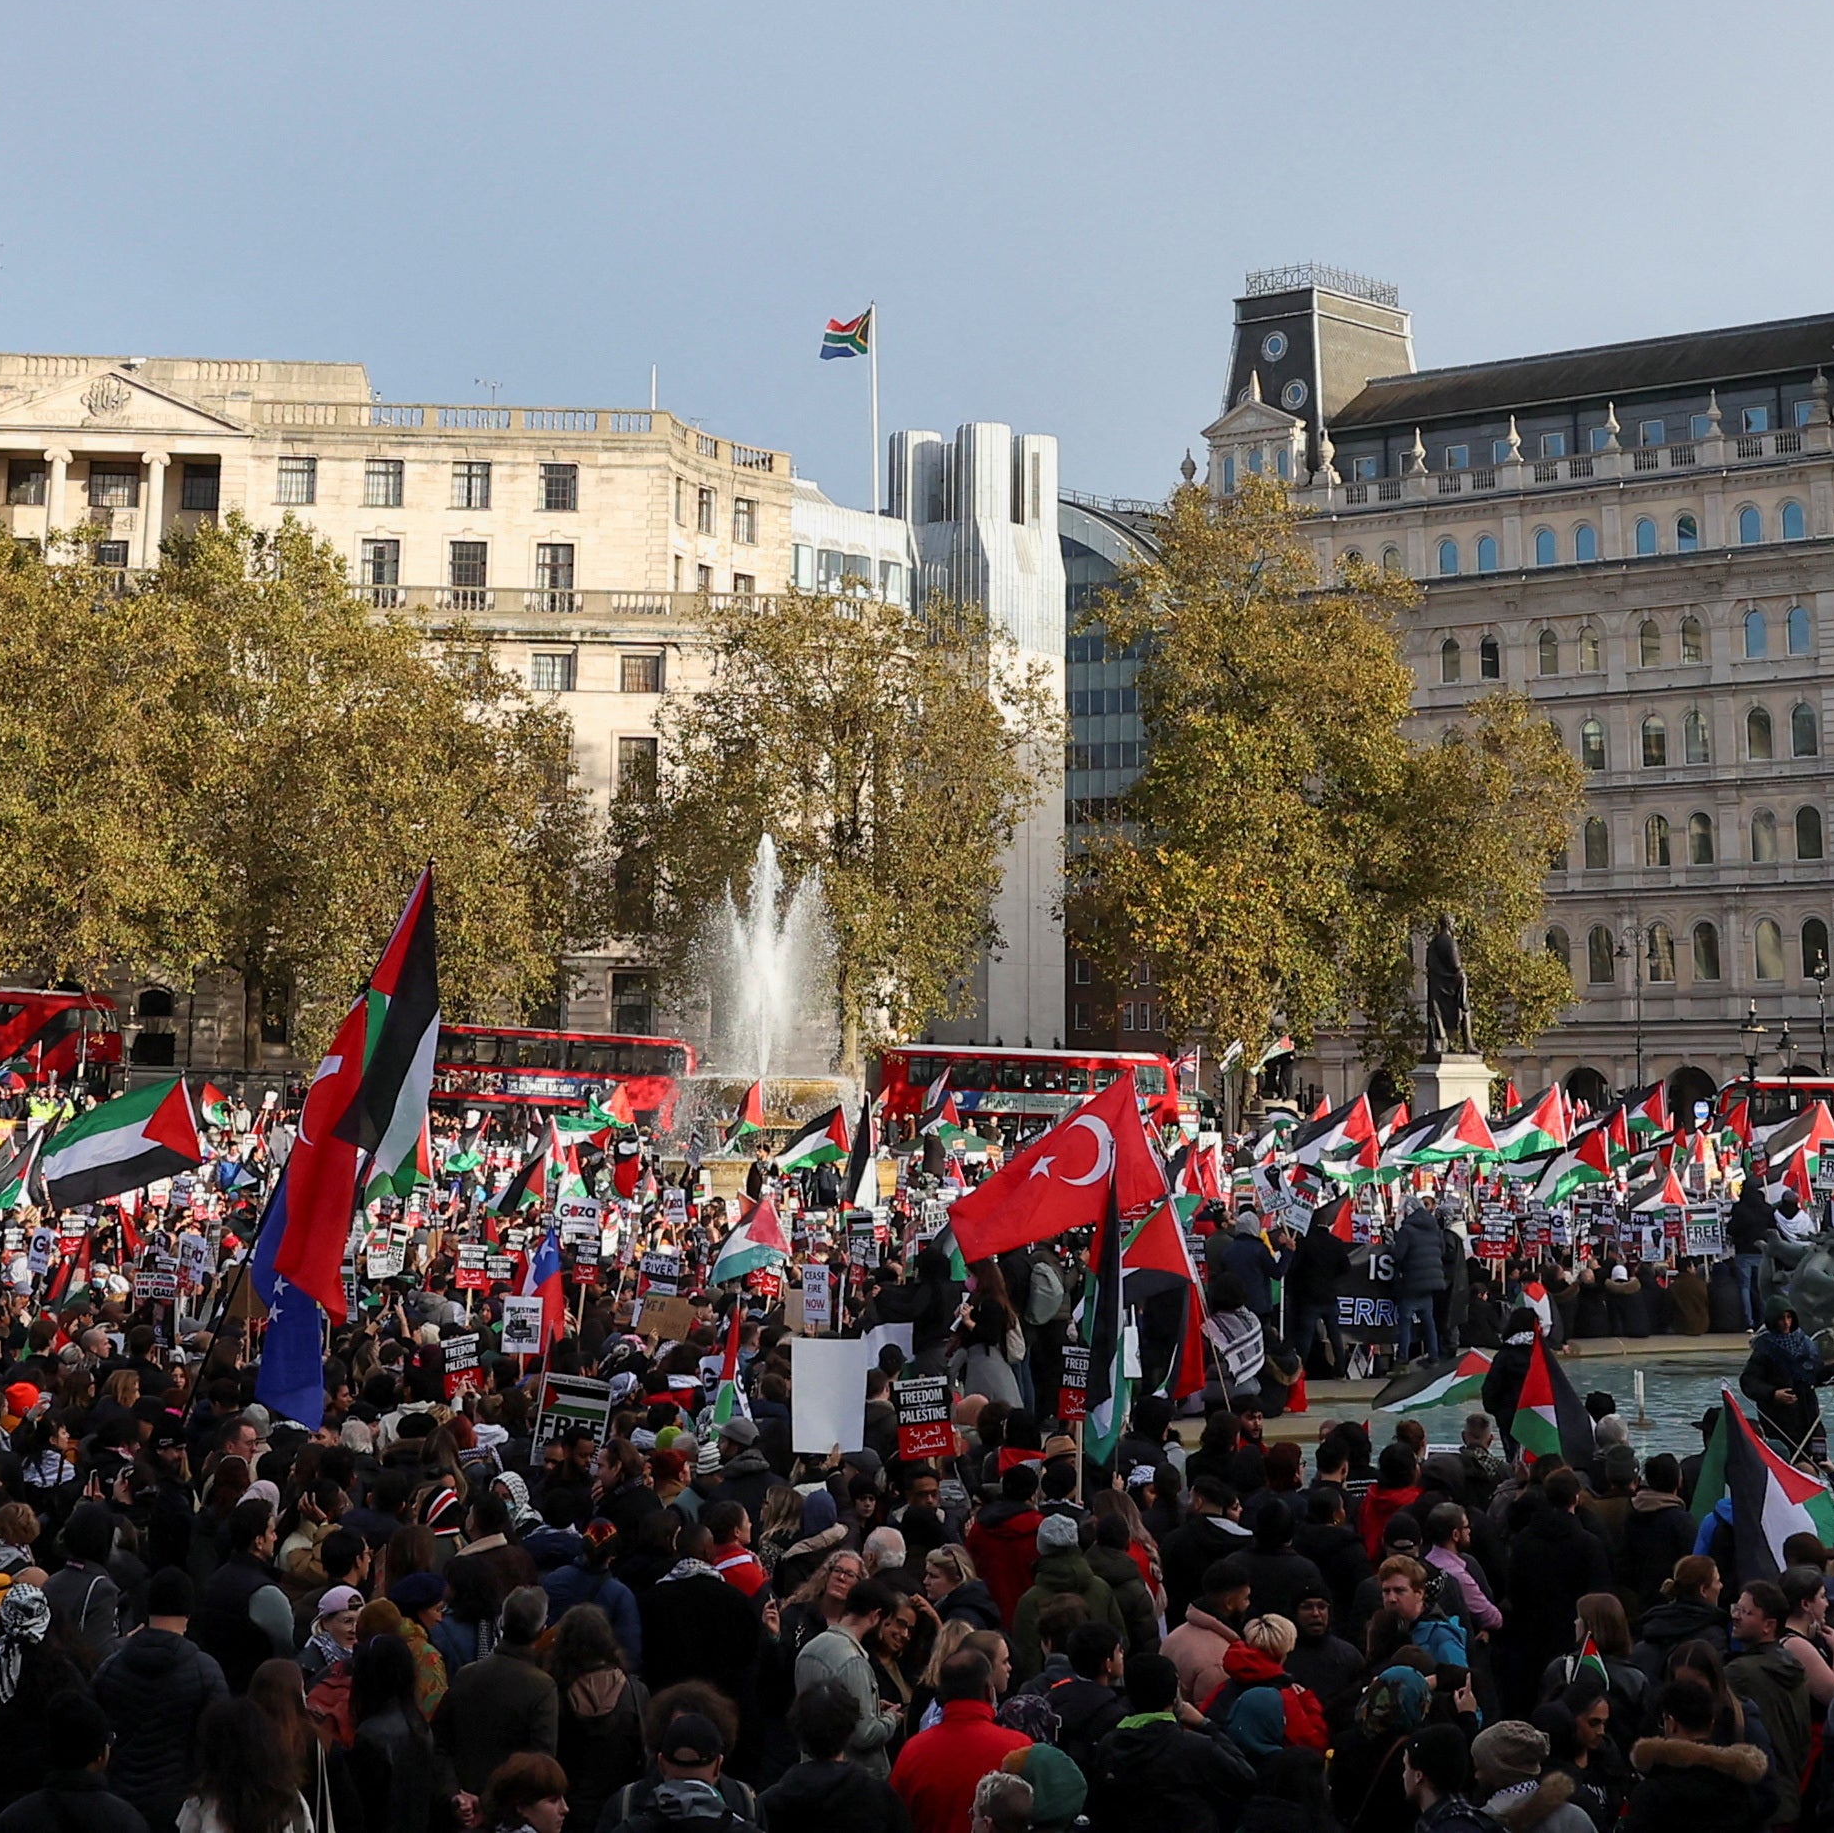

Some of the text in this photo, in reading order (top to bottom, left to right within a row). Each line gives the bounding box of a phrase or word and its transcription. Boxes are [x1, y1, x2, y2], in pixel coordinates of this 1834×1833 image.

[1687, 1225, 1719, 1238] FREE
[804, 1270, 826, 1281] CEASE
[137, 1287, 150, 1296] IN
[807, 1283, 822, 1293] FIRE
[805, 1298, 825, 1309] NOW
[1065, 1356, 1090, 1371] FREED
[1062, 1373, 1087, 1388] PALES
[899, 1388, 943, 1405] FREEDOM
[899, 1406, 948, 1424] PALESTINE
